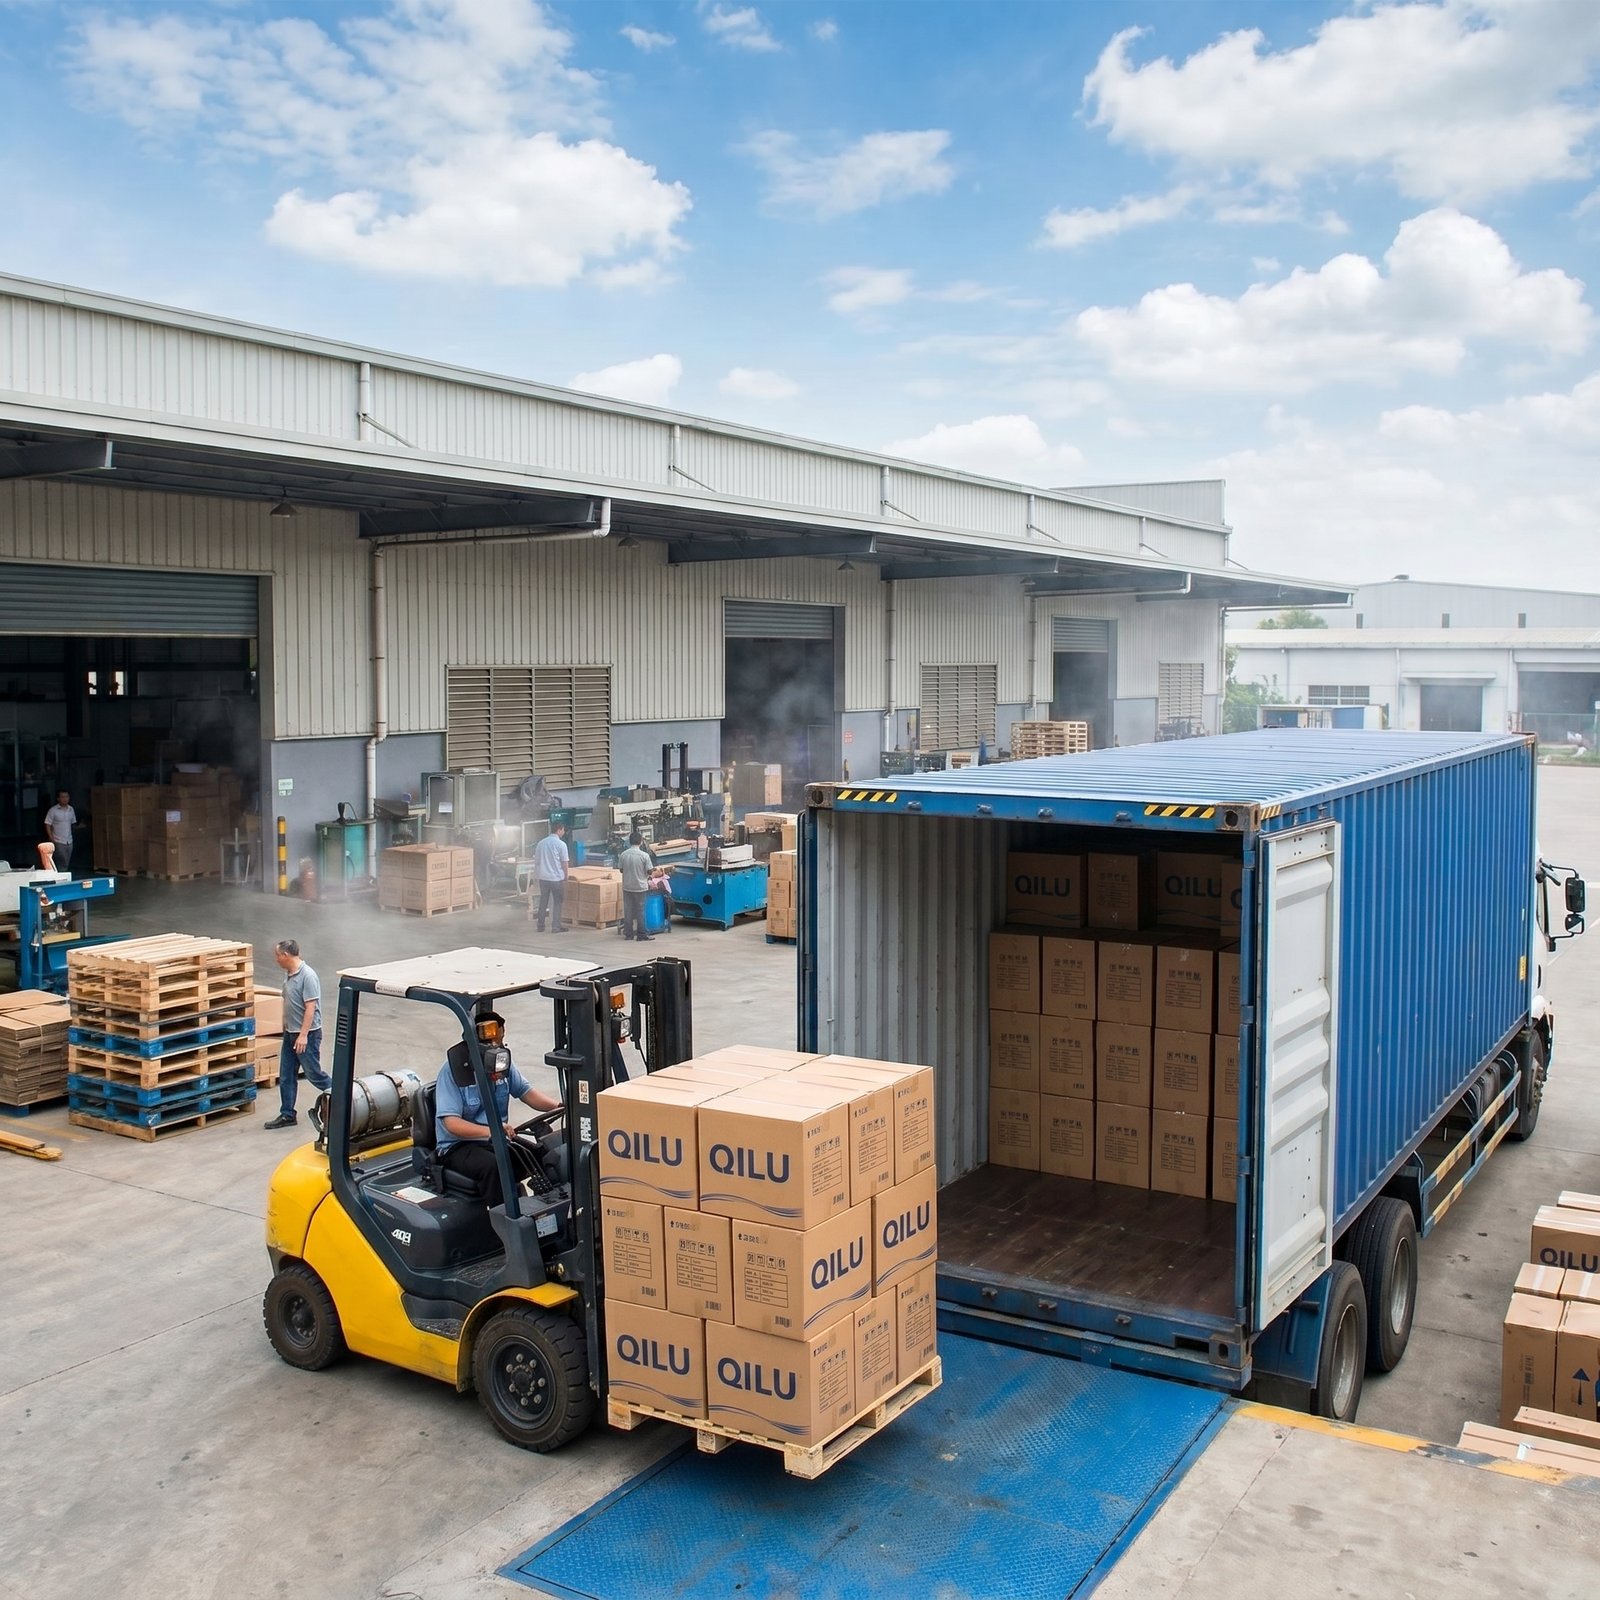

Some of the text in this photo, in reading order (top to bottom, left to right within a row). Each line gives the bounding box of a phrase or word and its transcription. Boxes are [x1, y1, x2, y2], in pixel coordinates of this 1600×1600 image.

[1014, 875, 1071, 897] QILU
[1164, 875, 1222, 898] QILU
[608, 1129, 682, 1167] QILU
[709, 1143, 790, 1183] QILU
[883, 1200, 930, 1248] QILU
[811, 1235, 863, 1290] QILU
[1540, 1247, 1599, 1273] QILU
[616, 1334, 690, 1375] QILU
[717, 1357, 796, 1400] QILU
